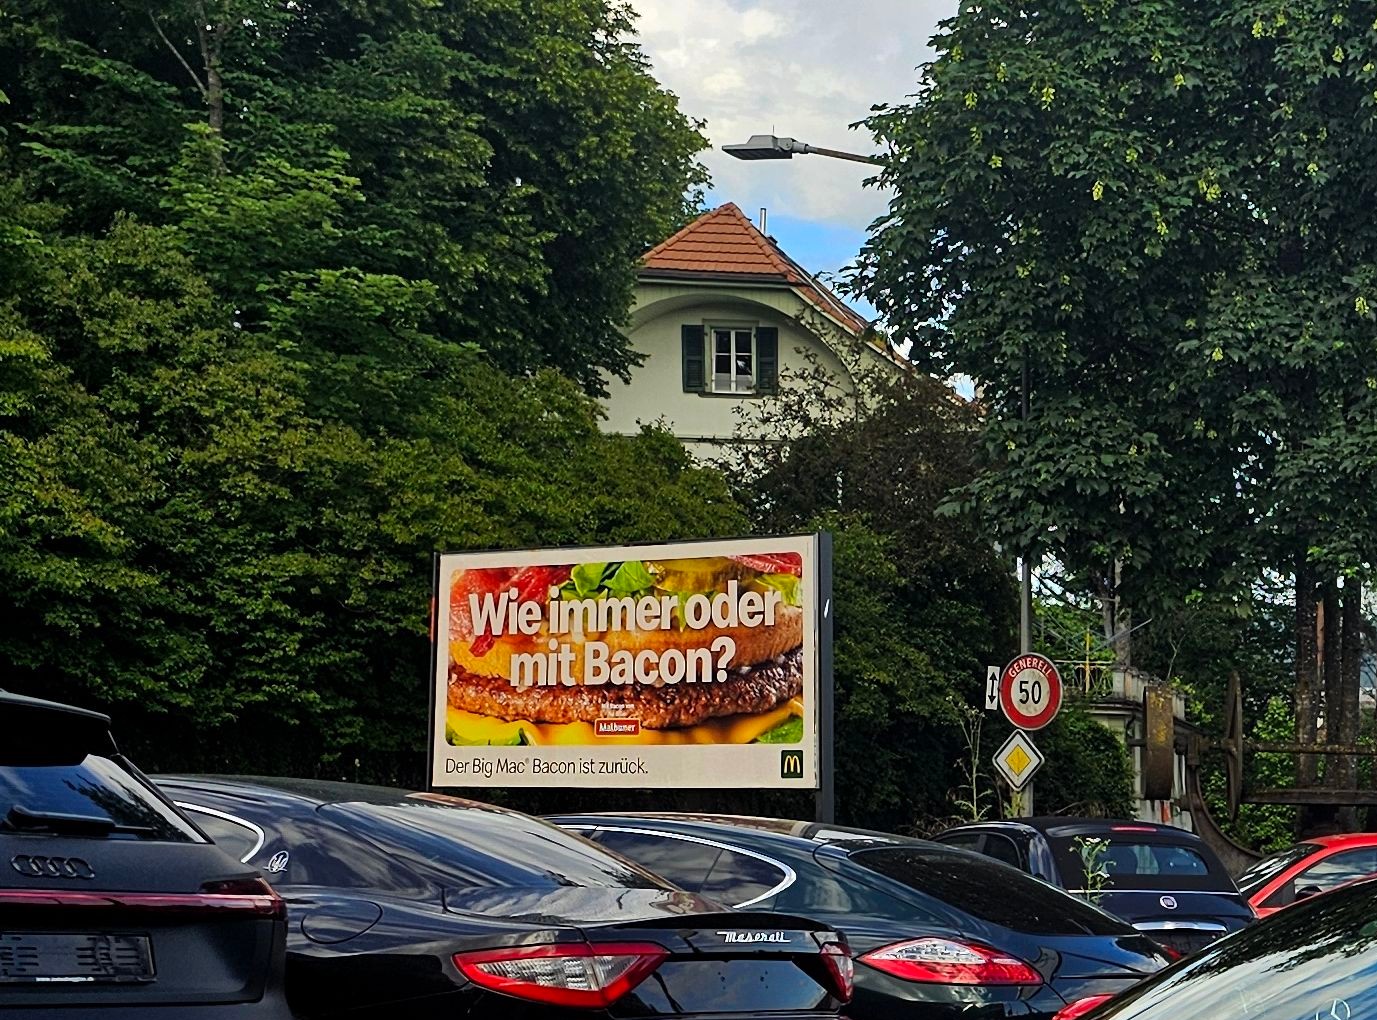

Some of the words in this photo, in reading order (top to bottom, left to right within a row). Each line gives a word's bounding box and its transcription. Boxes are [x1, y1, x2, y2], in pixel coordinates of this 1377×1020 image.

[468, 587, 542, 636] Wie
[549, 585, 679, 635] immer
[684, 579, 782, 630] oder
[510, 638, 577, 687] mit
[583, 635, 736, 686] Bacon?
[1008, 657, 1052, 679] GENERELL
[1018, 680, 1042, 705] 50
[445, 758, 469, 774] Der
[472, 757, 493, 779] Big
[532, 758, 576, 774] Bacon
[579, 758, 596, 774] ist
[598, 757, 649, 774] zurück.
[717, 931, 792, 943] Maserati
